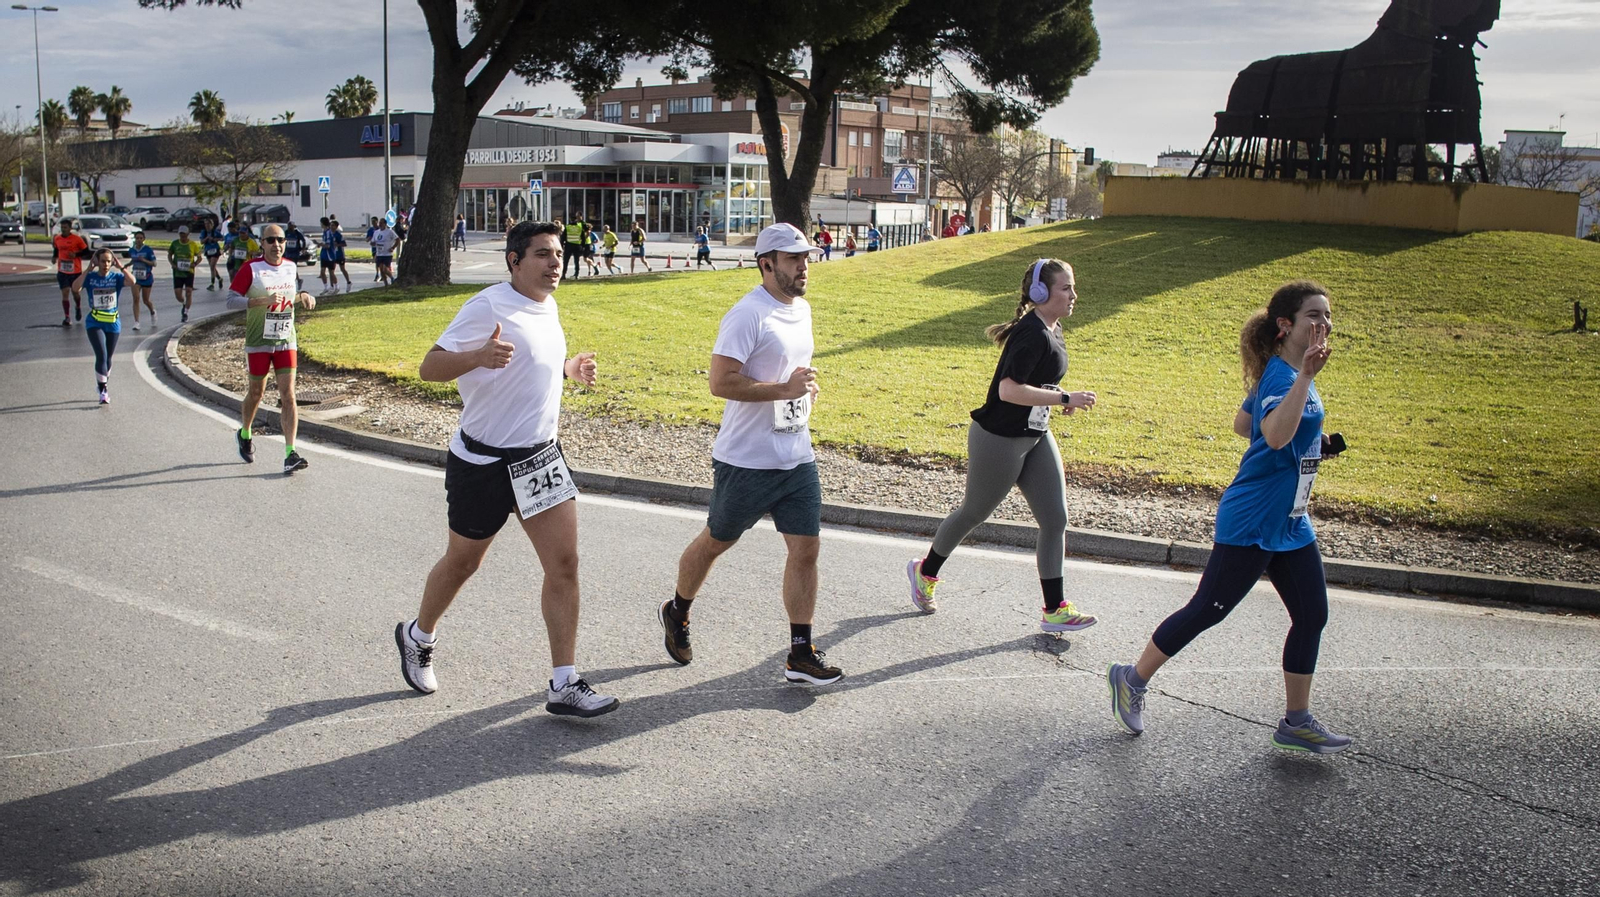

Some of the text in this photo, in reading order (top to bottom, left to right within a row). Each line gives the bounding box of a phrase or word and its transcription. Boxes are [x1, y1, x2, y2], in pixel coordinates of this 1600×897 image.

[360, 123, 400, 143] ALDI
[469, 150, 506, 164] PARRILLA
[507, 149, 532, 163] DESDE
[535, 148, 557, 163] 1954
[513, 452, 559, 478] POPULAR JEREZ
[527, 465, 564, 497] 245
